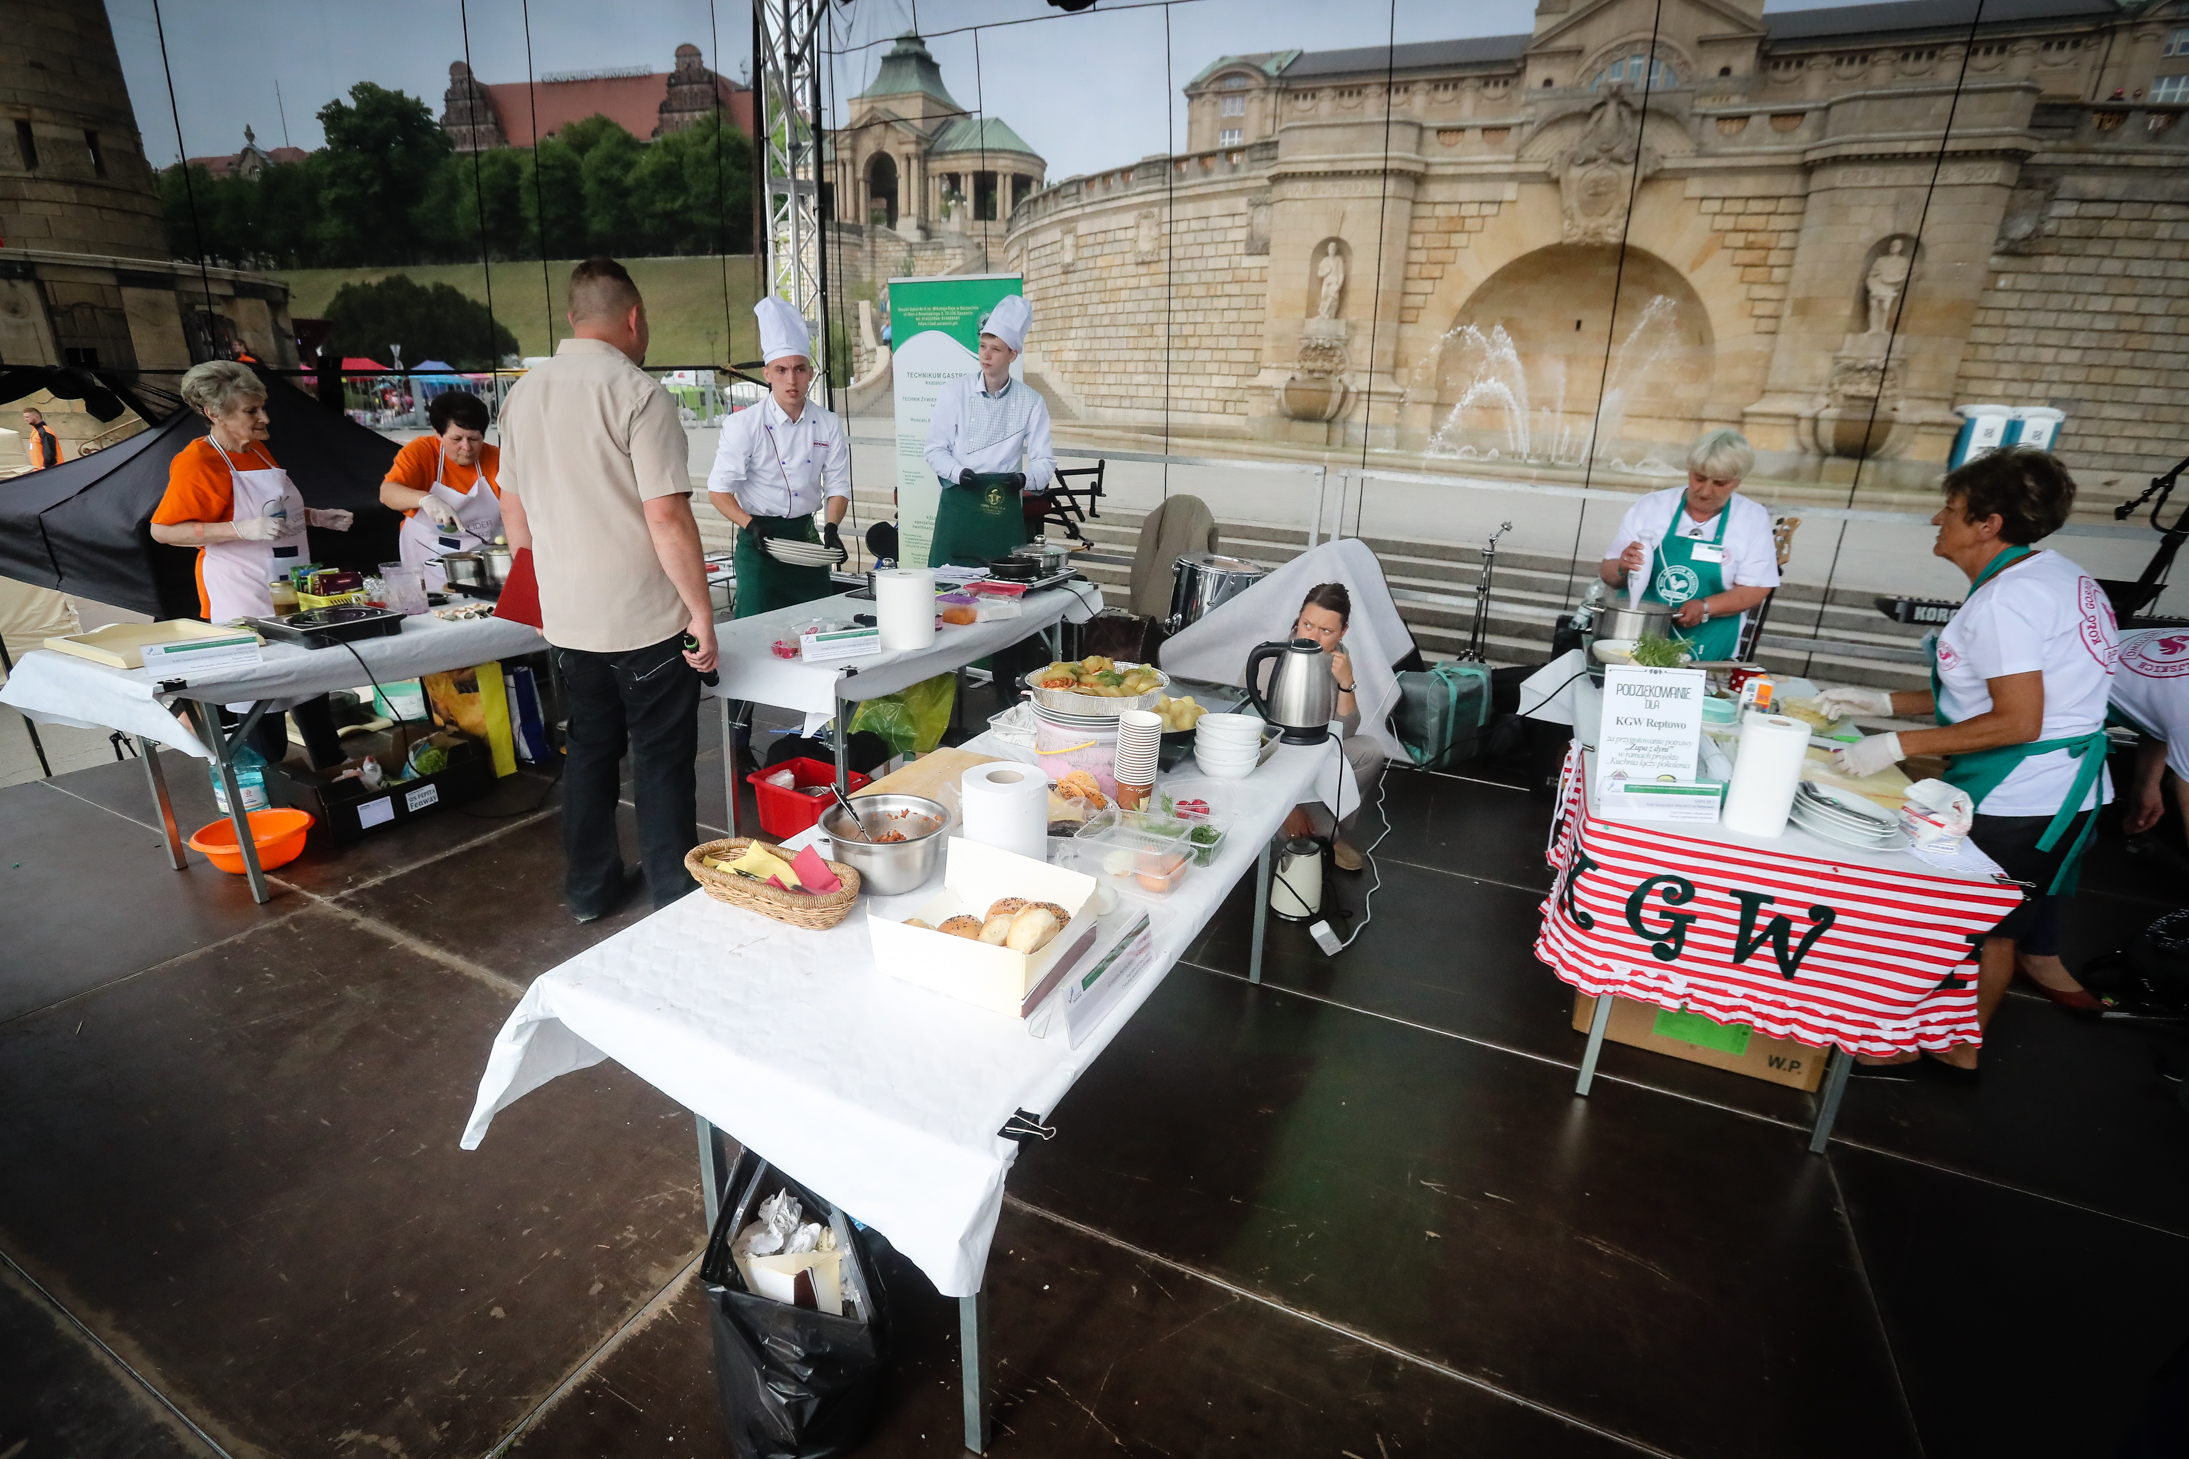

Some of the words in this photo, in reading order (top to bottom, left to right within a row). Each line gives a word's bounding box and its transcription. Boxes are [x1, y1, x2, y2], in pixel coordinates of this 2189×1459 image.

[1616, 683, 1692, 700] PODZIĘKOWANIE
[1645, 700, 1660, 709] DLA
[1616, 716, 1645, 726] KGW
[1646, 718, 1687, 730] Reptowo
[410, 796, 437, 810] Fenway
[1768, 1054, 1802, 1074] W.P.
